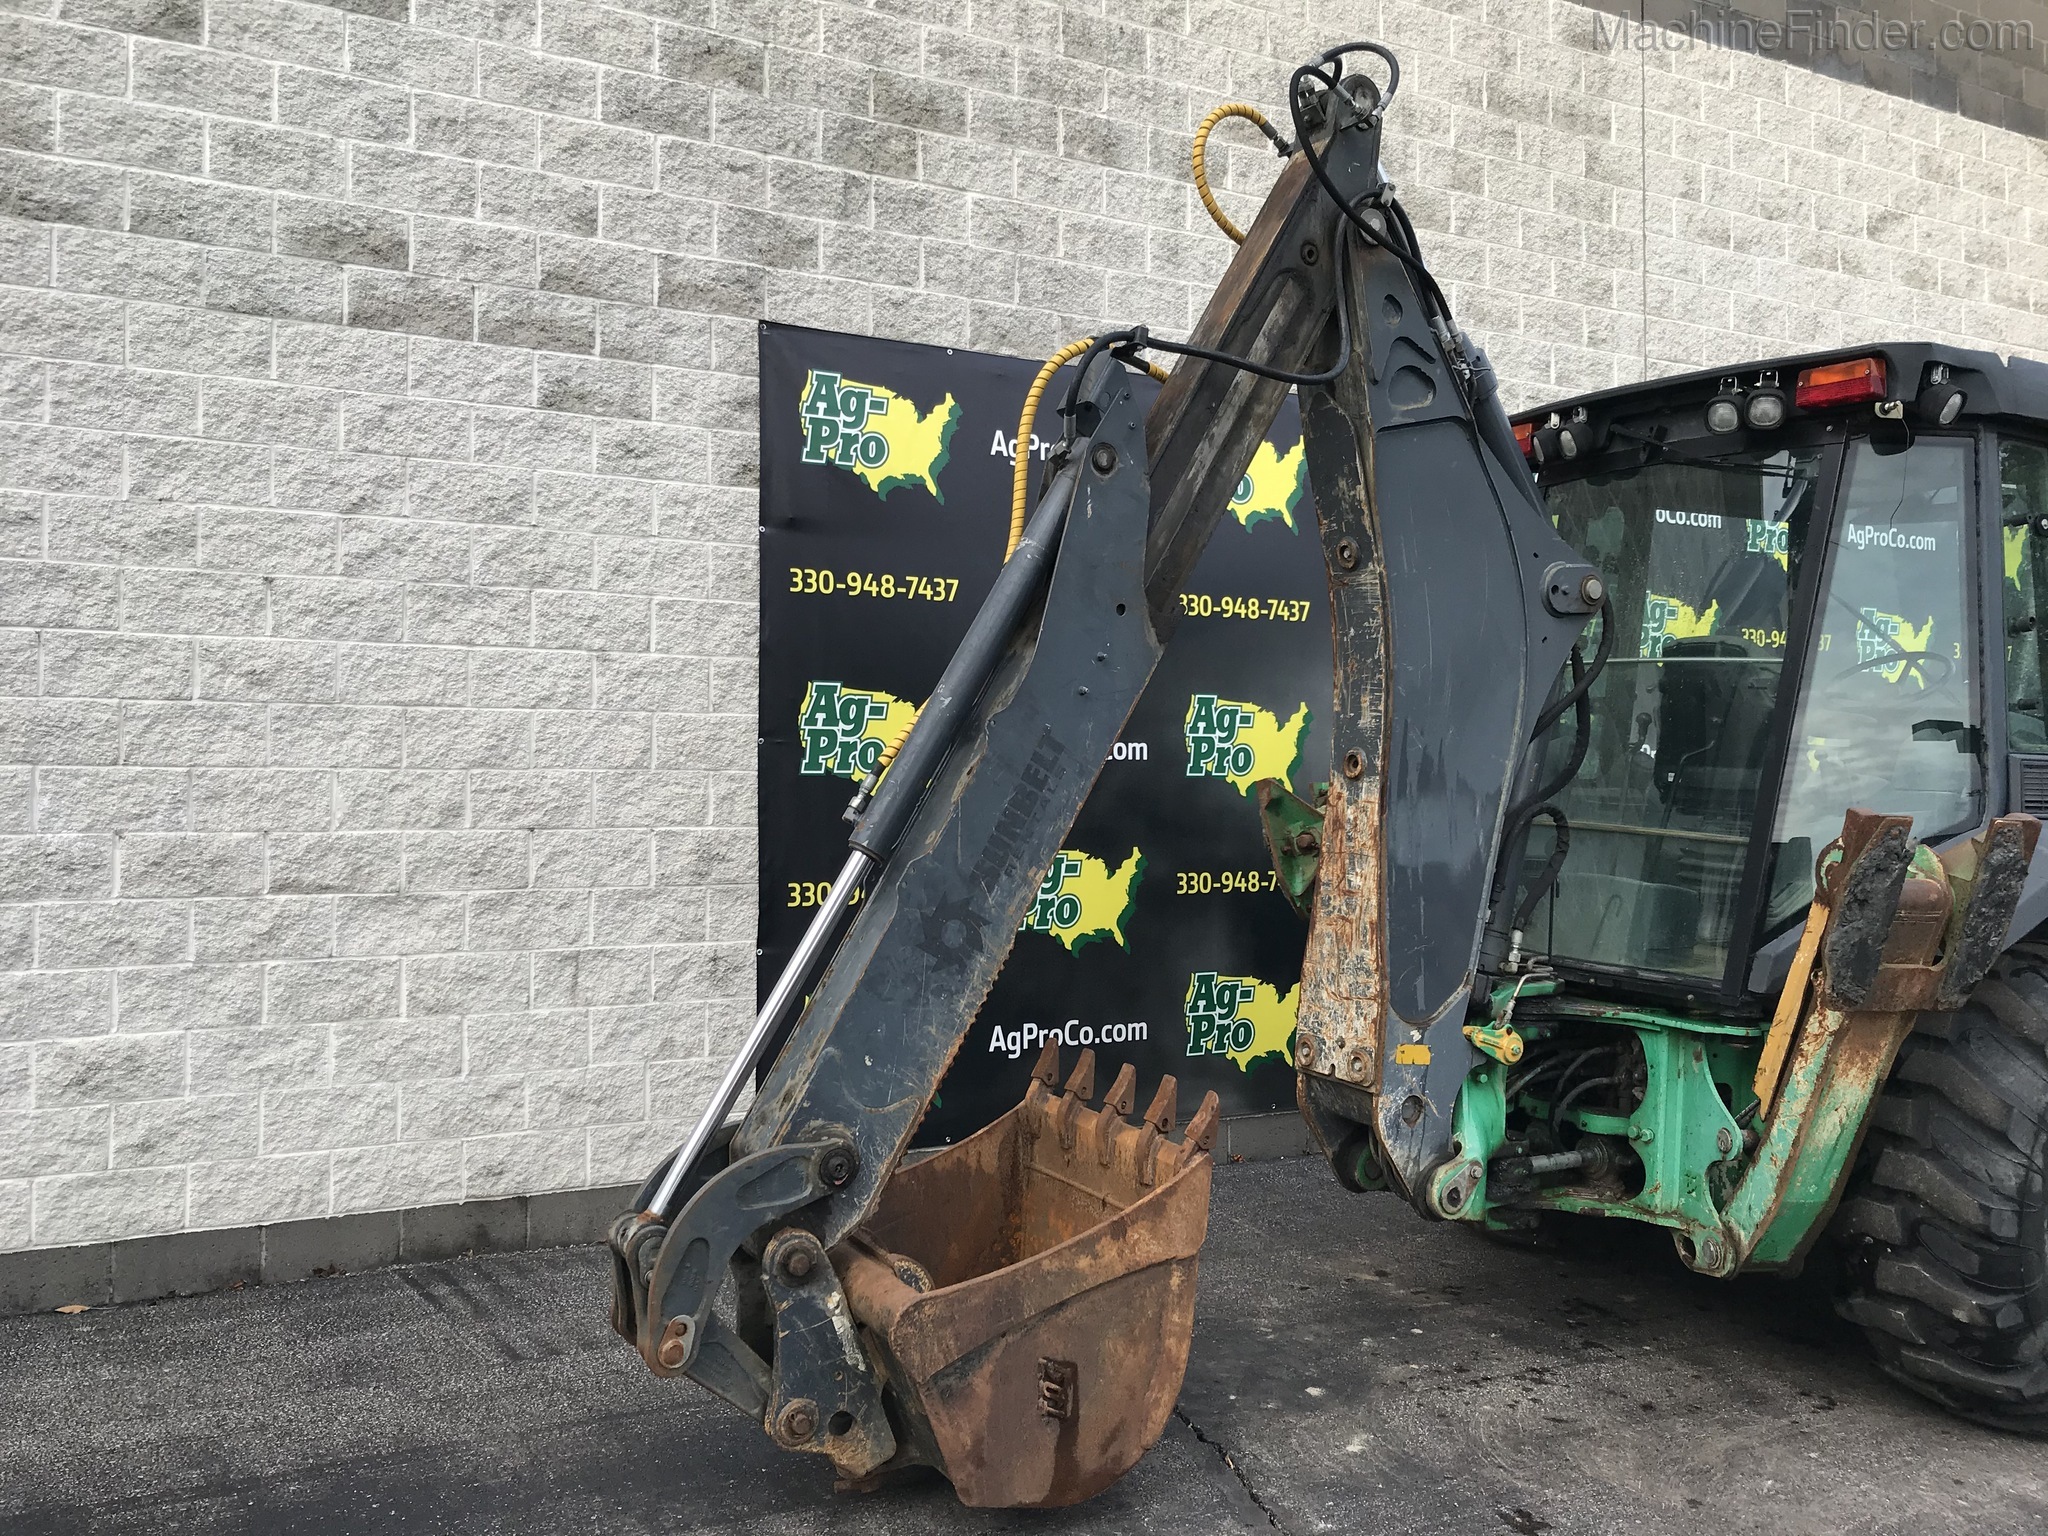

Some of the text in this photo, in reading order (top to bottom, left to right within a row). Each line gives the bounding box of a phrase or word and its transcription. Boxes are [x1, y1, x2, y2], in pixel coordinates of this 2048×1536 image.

[801, 417, 889, 469] Pro
[1747, 518, 1788, 553] Pro
[1847, 523, 1936, 551] AgProCo.com
[789, 567, 959, 602] 330-948-7437
[1186, 694, 1254, 743] Ag-
[1186, 733, 1254, 777] Pro
[1176, 870, 1281, 895] 330-948-7
[1186, 971, 1254, 1021] Ag-
[988, 1019, 1148, 1059] AgProCo.com
[1186, 1012, 1255, 1056] Pro
